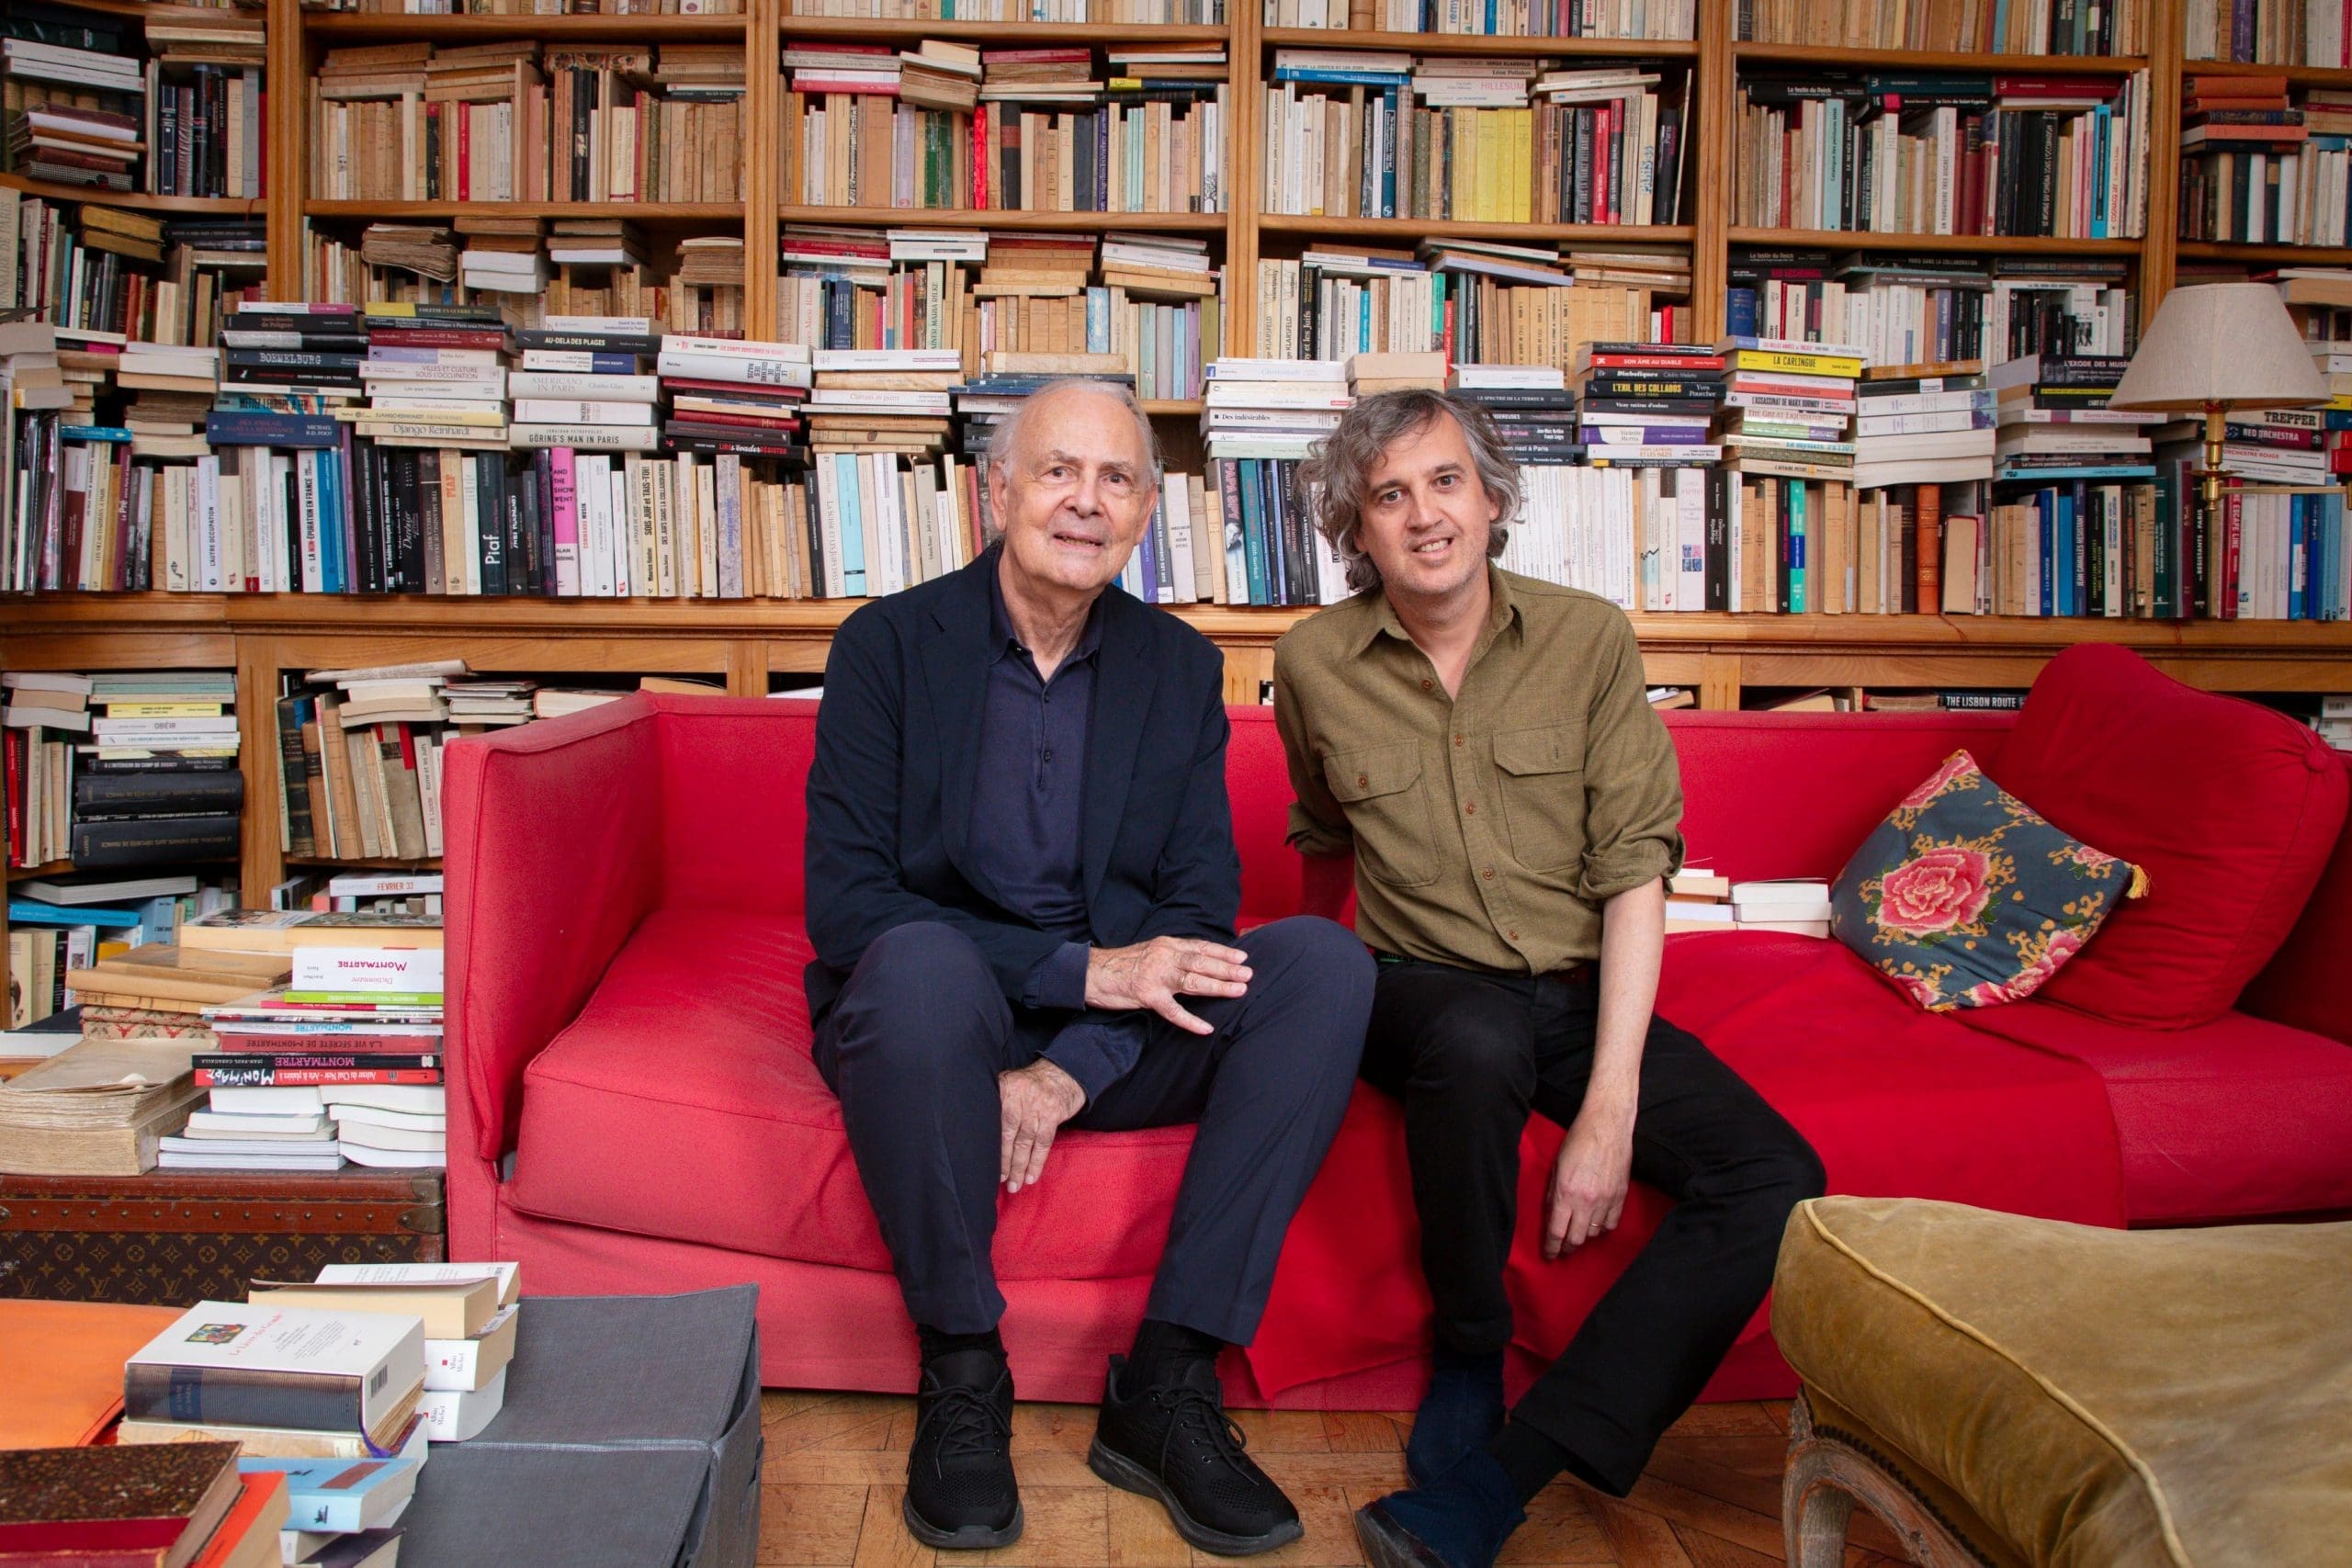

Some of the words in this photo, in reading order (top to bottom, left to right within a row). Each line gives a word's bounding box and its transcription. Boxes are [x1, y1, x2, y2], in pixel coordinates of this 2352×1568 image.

[1481, 81, 1523, 91] HILLESUM
[1303, 310, 1311, 330] Juifs
[1303, 331, 1311, 342] les
[259, 352, 322, 365] BOEMELBURG
[1773, 355, 1781, 365] LA
[1782, 356, 1816, 368] CARLINGUE
[531, 377, 582, 385] AMERICANS
[1612, 384, 1633, 392] L'EXIL
[1634, 384, 1646, 392] DES
[1648, 384, 1681, 393] COLLABOS
[1752, 397, 1781, 406] L'ASSASSINAT
[1788, 399, 1802, 407] MARX
[1762, 411, 1783, 419] GREAT
[2264, 412, 2316, 426] TREPPER
[393, 424, 426, 434] Django
[428, 424, 470, 435] Reinhardt
[2243, 428, 2256, 437] RED
[2258, 429, 2299, 441] ORCHESTRA
[529, 434, 565, 443] GÖRING'S
[567, 434, 584, 443] MAN
[597, 435, 619, 444] PARIS
[642, 467, 650, 497] TAIS-TOI!
[1224, 462, 1237, 494] PAPA
[305, 478, 313, 500] FRANCE
[447, 474, 456, 498] PIAF
[306, 500, 313, 508] EN
[1226, 495, 1239, 520] SPY
[643, 505, 651, 519] JUIF
[2232, 505, 2240, 531] ESCAPE
[306, 509, 315, 539] ÉPURATION
[644, 521, 652, 535] SOIS
[434, 533, 439, 542] OF
[2232, 533, 2240, 549] LINE
[483, 534, 501, 564] Piaf
[2076, 572, 2085, 586] JEAN
[1946, 696, 1961, 706] THE
[1962, 696, 1990, 707] LISBON
[1992, 697, 2016, 707] ROUTE
[377, 882, 404, 891] FÉVRIER
[337, 961, 407, 971] MONTMARTRE
[351, 976, 393, 985] Dictionnaire
[294, 1023, 353, 1032] MONTMARTRE
[245, 1039, 303, 1047] MONTMARTRE
[275, 1056, 355, 1066] MONTMARTRE
[278, 1072, 283, 1080] à
[286, 1070, 302, 1080] plaisirs
[303, 1071, 309, 1079] &
[310, 1071, 320, 1080] Arts
[323, 1071, 336, 1079] Noir
[337, 1071, 349, 1079] Chat
[351, 1071, 357, 1079] du
[358, 1071, 377, 1079] Autour
[449, 1355, 458, 1371] Albin
[457, 1352, 465, 1372] Michel
[430, 1407, 438, 1423] Albin
[437, 1405, 446, 1426] Michel
